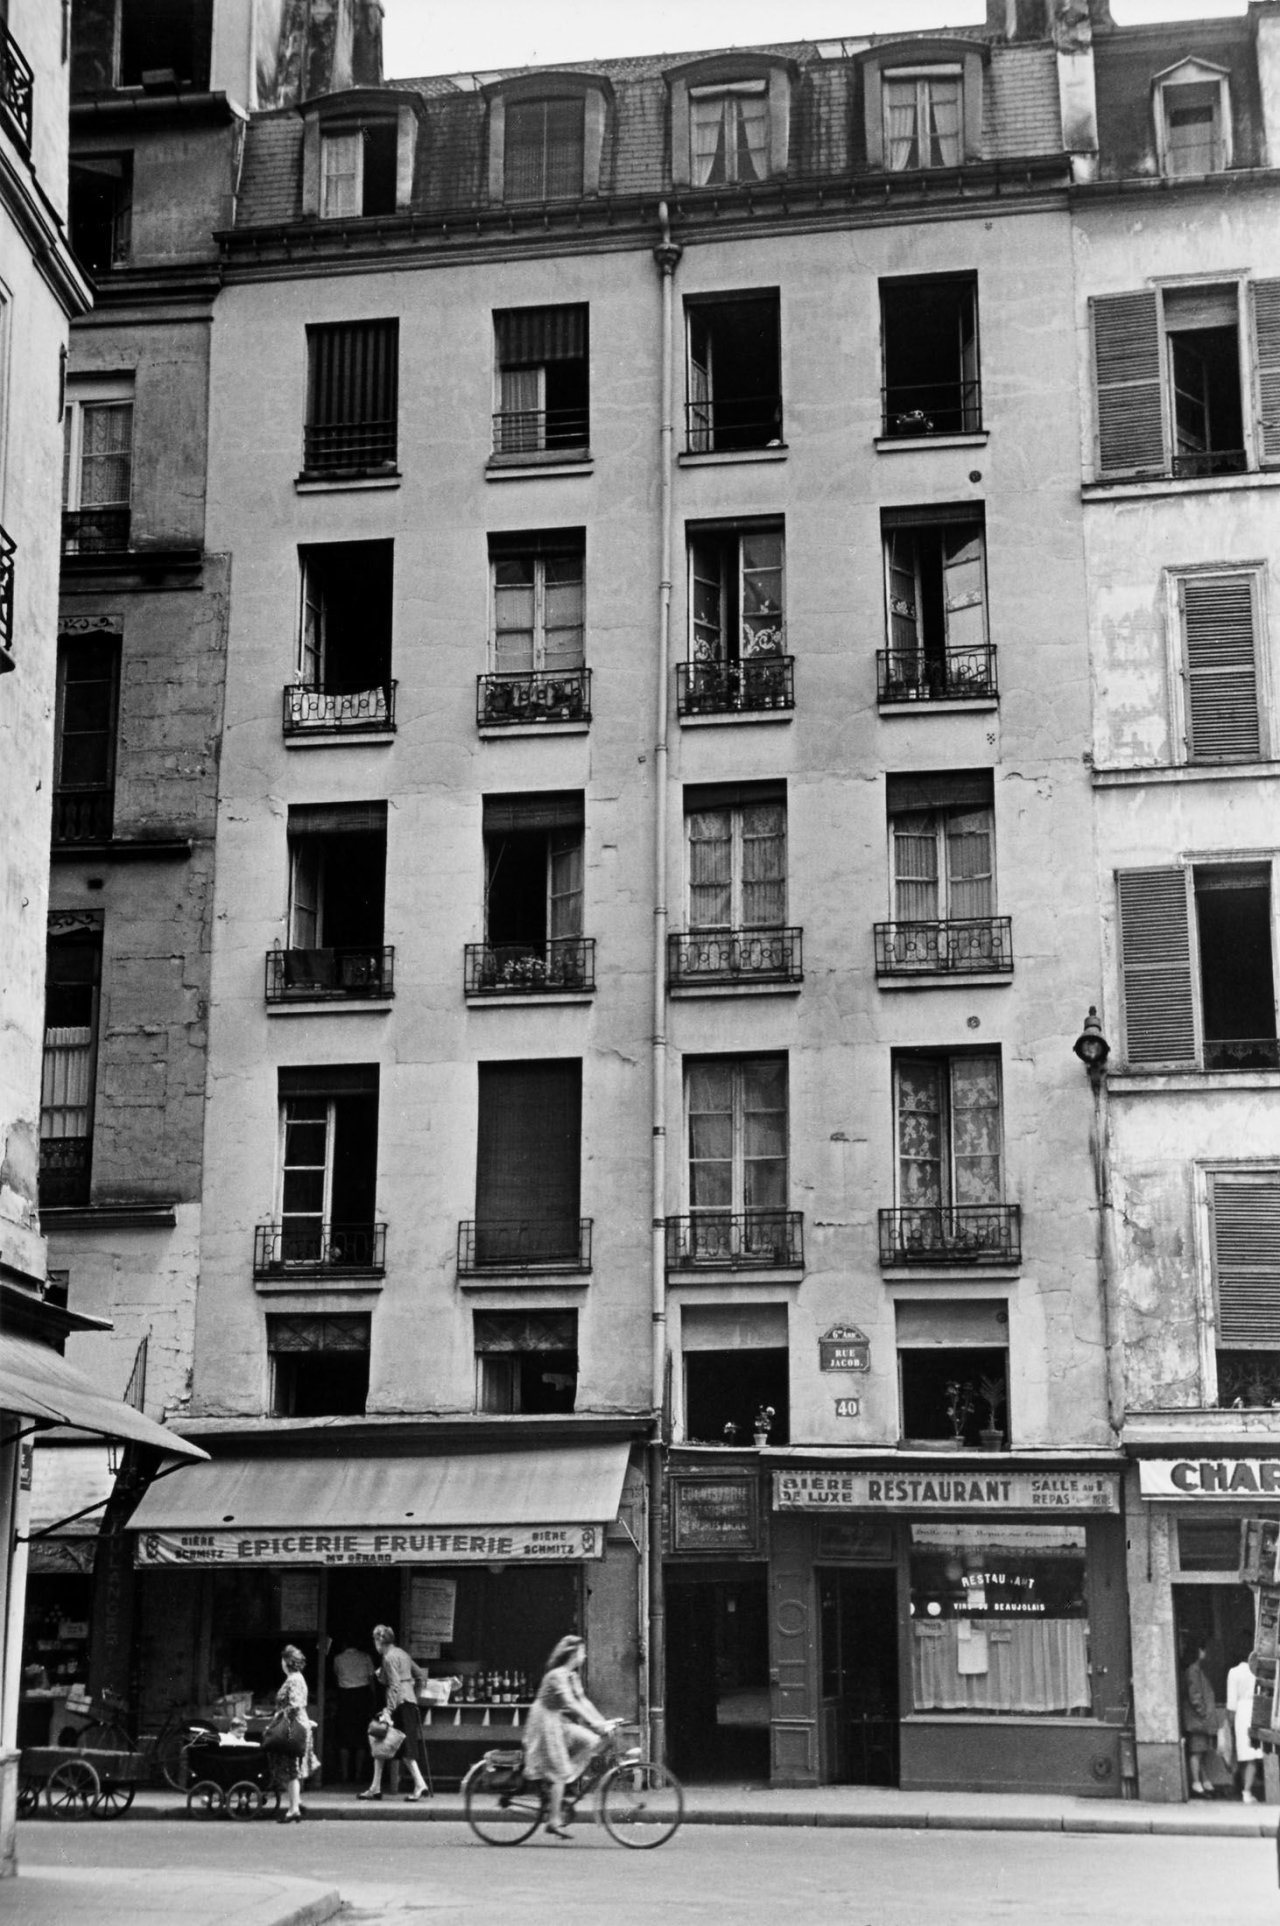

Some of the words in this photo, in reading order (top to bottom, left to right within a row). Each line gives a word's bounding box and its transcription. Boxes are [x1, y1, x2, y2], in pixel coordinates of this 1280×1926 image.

[835, 1349, 855, 1358] RUE
[838, 1401, 857, 1416] 40
[783, 1478, 853, 1490] BIÈRE
[1032, 1480, 1079, 1492] SALLE
[868, 1480, 1011, 1502] RESTAURANT
[809, 1492, 853, 1503] LUXE
[1032, 1494, 1070, 1505] REPAS
[181, 1536, 214, 1546] BIÈRE
[532, 1531, 567, 1541] BIÈRE
[374, 1535, 512, 1554] FRUITERIE
[524, 1545, 574, 1554] SCHMITZ
[961, 1573, 1035, 1589] RESTAUANT
[994, 1603, 1045, 1611] BEAUJOLAIS
